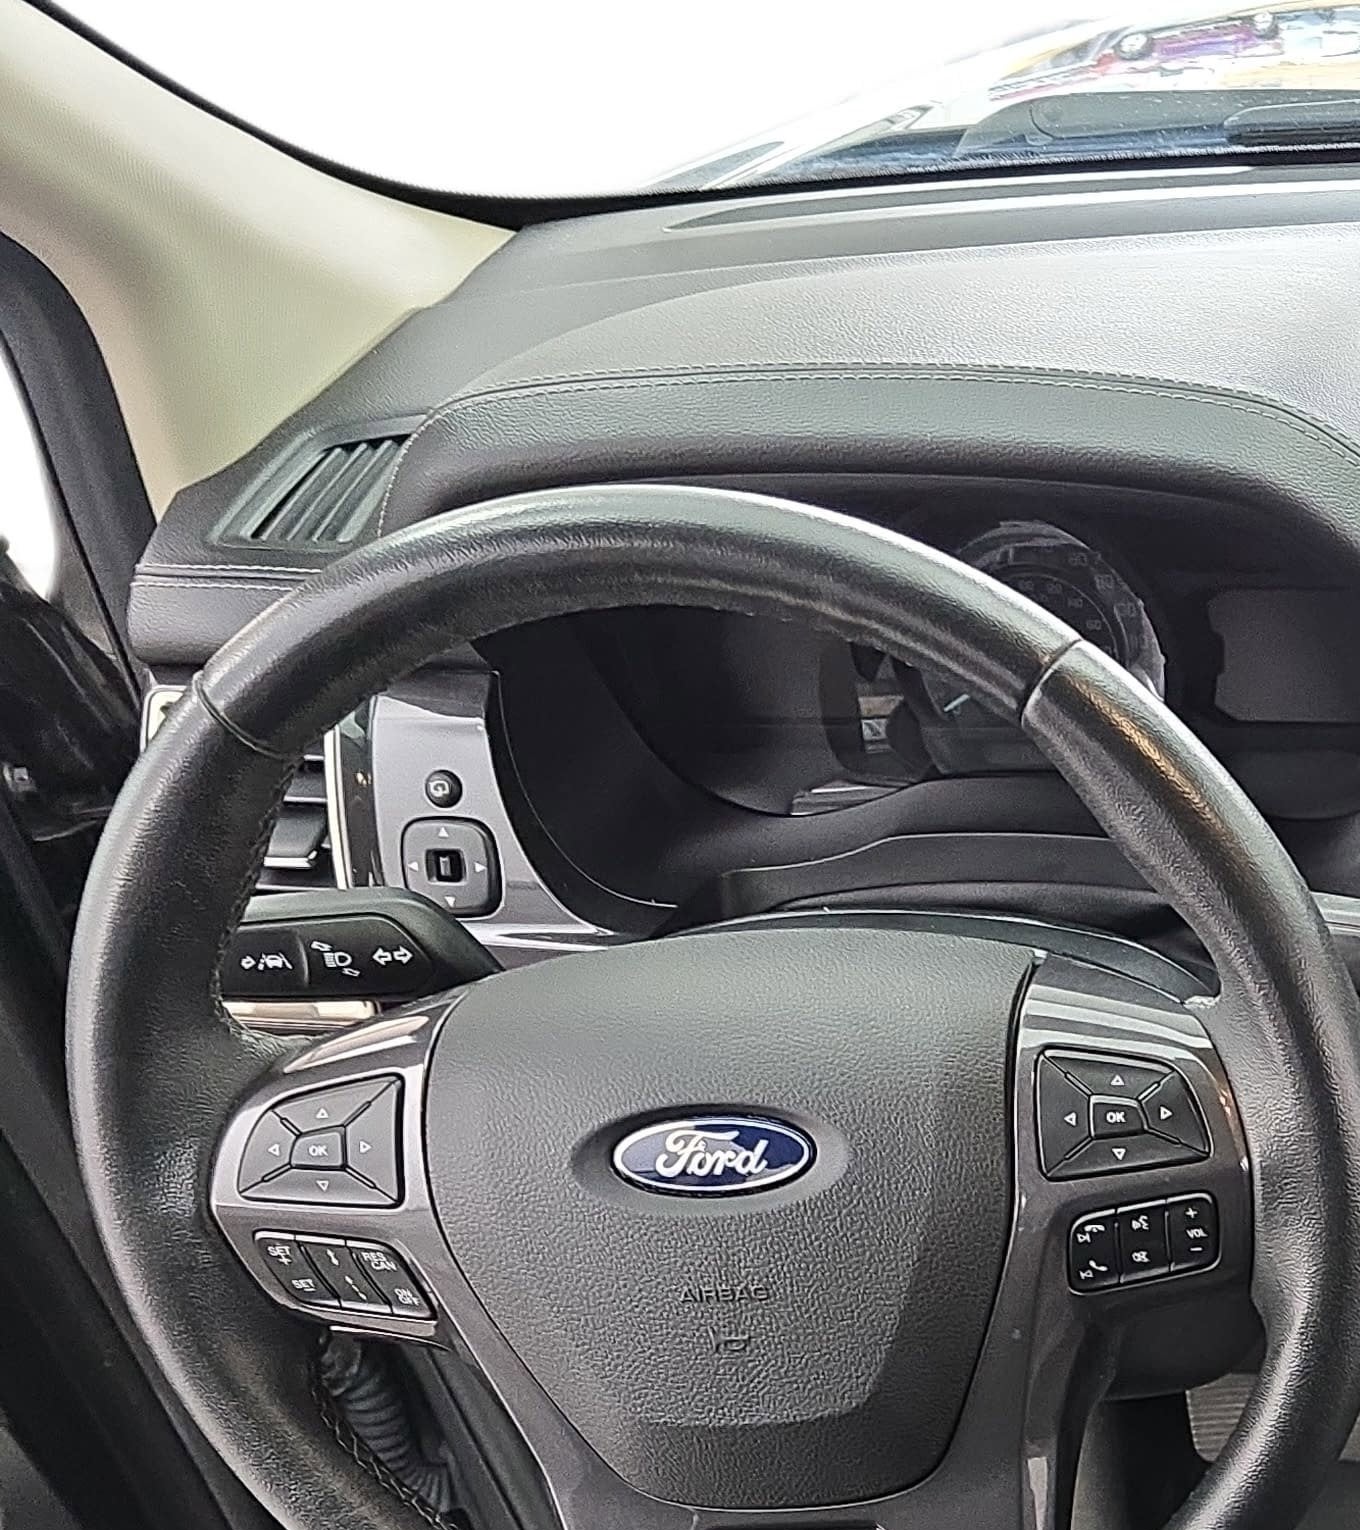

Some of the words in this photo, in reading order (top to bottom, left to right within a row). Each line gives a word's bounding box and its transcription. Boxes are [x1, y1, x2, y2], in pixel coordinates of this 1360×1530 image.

[1106, 1112, 1125, 1123] OK
[308, 1144, 329, 1156] OK
[654, 1129, 769, 1178] Ford
[1186, 1228, 1208, 1239] VOL
[267, 1245, 291, 1257] SET
[361, 1251, 387, 1262] RES
[370, 1260, 398, 1272] CAN
[291, 1278, 315, 1289] SET
[680, 1284, 769, 1304] AIRBAG
